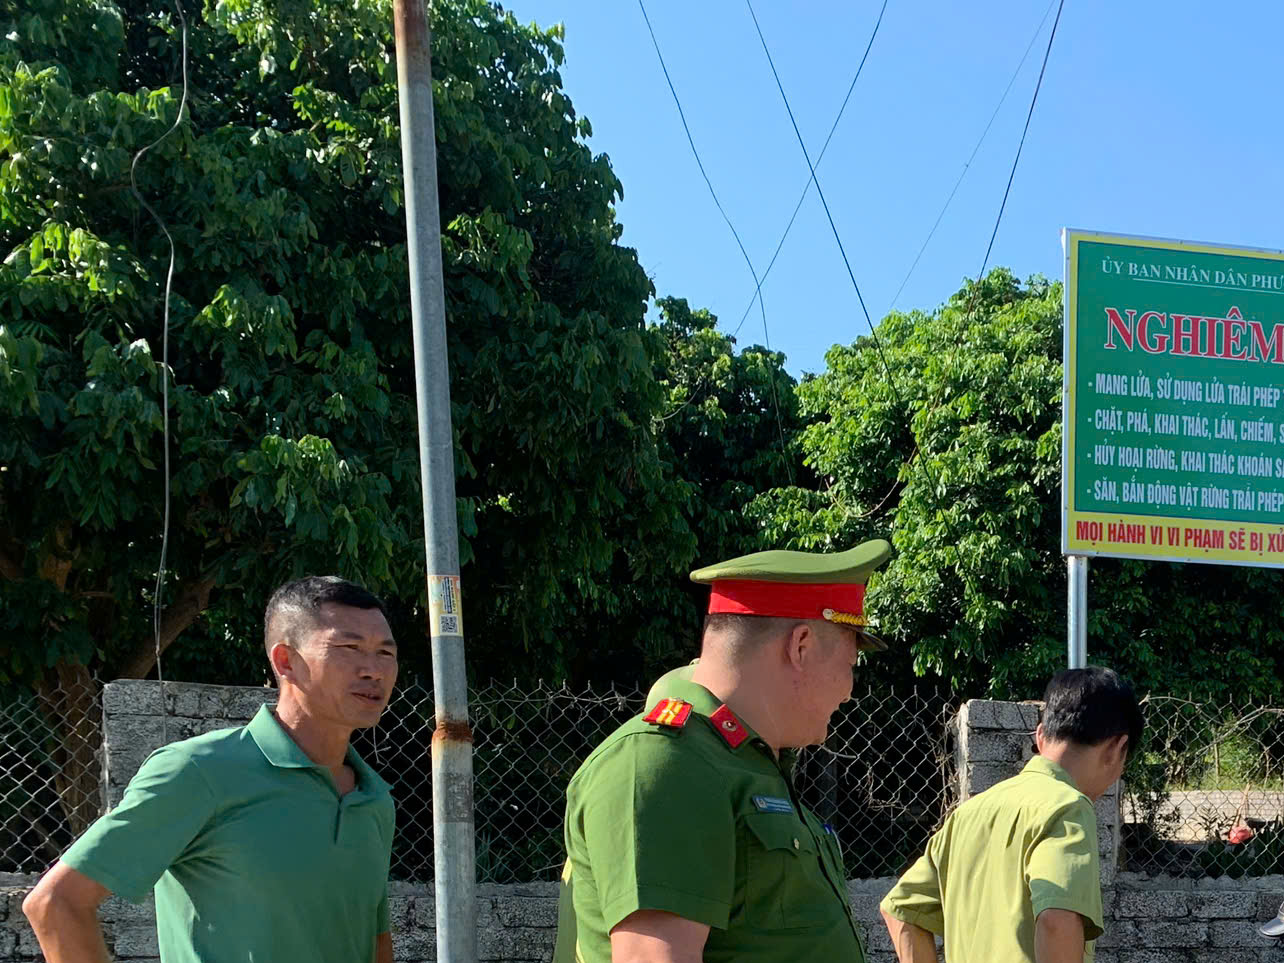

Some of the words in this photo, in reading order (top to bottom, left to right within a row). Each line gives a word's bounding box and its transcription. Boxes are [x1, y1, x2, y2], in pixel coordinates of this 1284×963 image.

[1102, 256, 1124, 274] ỦY
[1128, 263, 1161, 279] BAN
[1165, 265, 1211, 283] NHÂN
[1214, 268, 1247, 286] DÂN
[1095, 373, 1128, 396] MANG
[1130, 370, 1154, 400] LỬA,
[1157, 372, 1173, 399] SỬ
[1174, 379, 1202, 405] DỤNG
[1205, 376, 1225, 404] LỬA
[1228, 382, 1250, 406] TRÁI
[1253, 384, 1280, 408] PHÉP
[1095, 406, 1123, 435] CHẶT,
[1127, 408, 1151, 436] PHÁ,
[1154, 413, 1179, 435] KHAI
[1182, 412, 1211, 440] THÁC,
[1214, 412, 1237, 442] LẤN,
[1240, 415, 1276, 445] CHIẾM,
[1094, 438, 1115, 466] HỦY
[1118, 446, 1143, 472] HOẠI
[1146, 444, 1178, 472] RỪNG,
[1181, 451, 1205, 473] KHAI
[1208, 450, 1235, 475] THÁC
[1237, 452, 1272, 477] KHOÁN
[1094, 476, 1119, 504] SĂN,
[1122, 475, 1144, 503] BẮN
[1147, 480, 1176, 509] ĐỘNG
[1179, 482, 1199, 511] VẬT
[1201, 484, 1229, 509] RỪNG
[1232, 486, 1255, 511] TRÁI
[1258, 489, 1284, 512] PHÉP
[1076, 521, 1103, 546] MỌI
[1108, 519, 1146, 545] HÀNH
[1150, 525, 1163, 546] VI
[1167, 527, 1180, 547] VI
[1184, 528, 1224, 553] PHẠM
[1229, 528, 1246, 551] SẼ
[1250, 532, 1263, 556] BỊ
